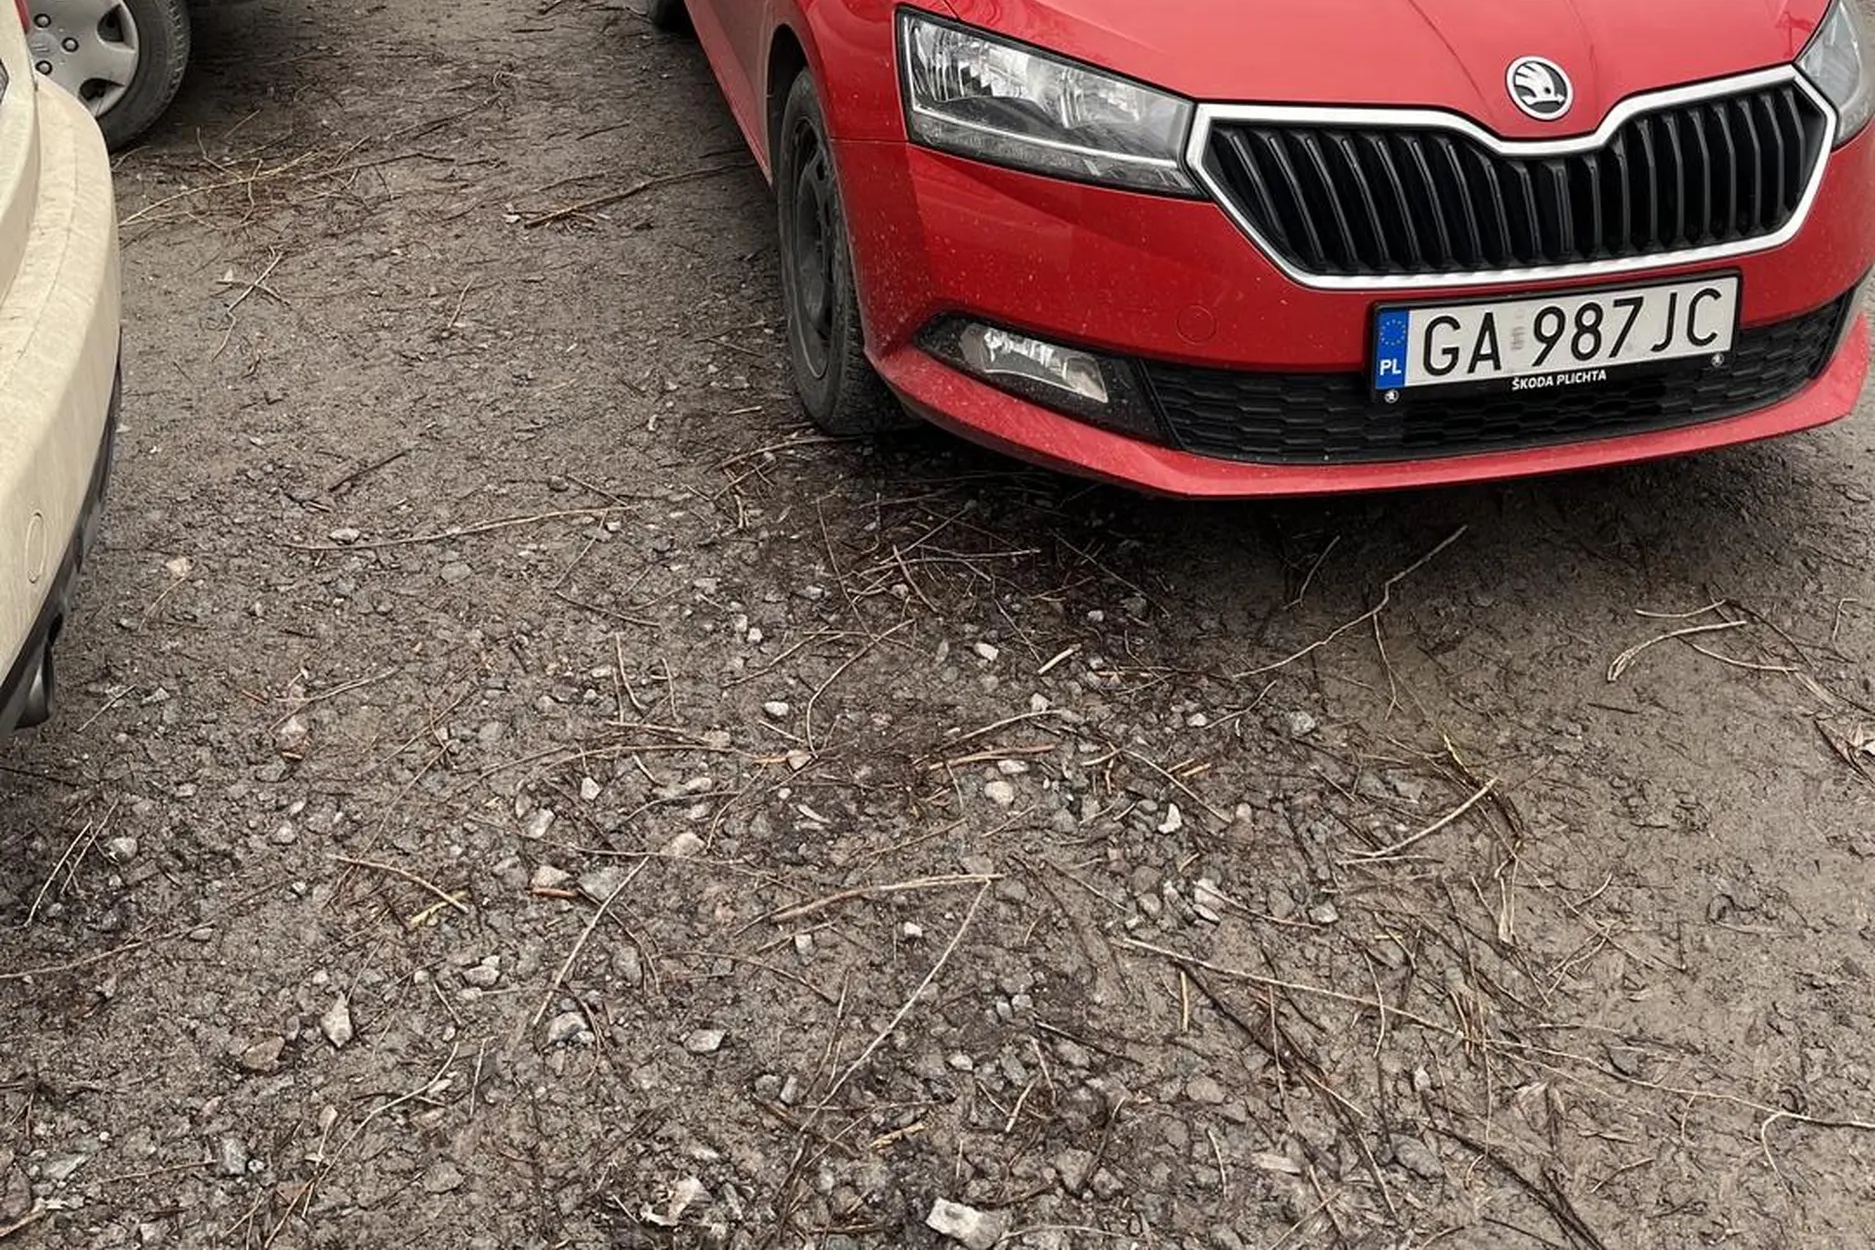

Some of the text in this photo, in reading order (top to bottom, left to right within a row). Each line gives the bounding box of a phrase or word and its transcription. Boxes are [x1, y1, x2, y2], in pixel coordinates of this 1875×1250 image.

[1422, 287, 1722, 377] GA 987JC
[1379, 358, 1402, 376] PL
[1511, 369, 1607, 391] ŠKODA PLICHTA
